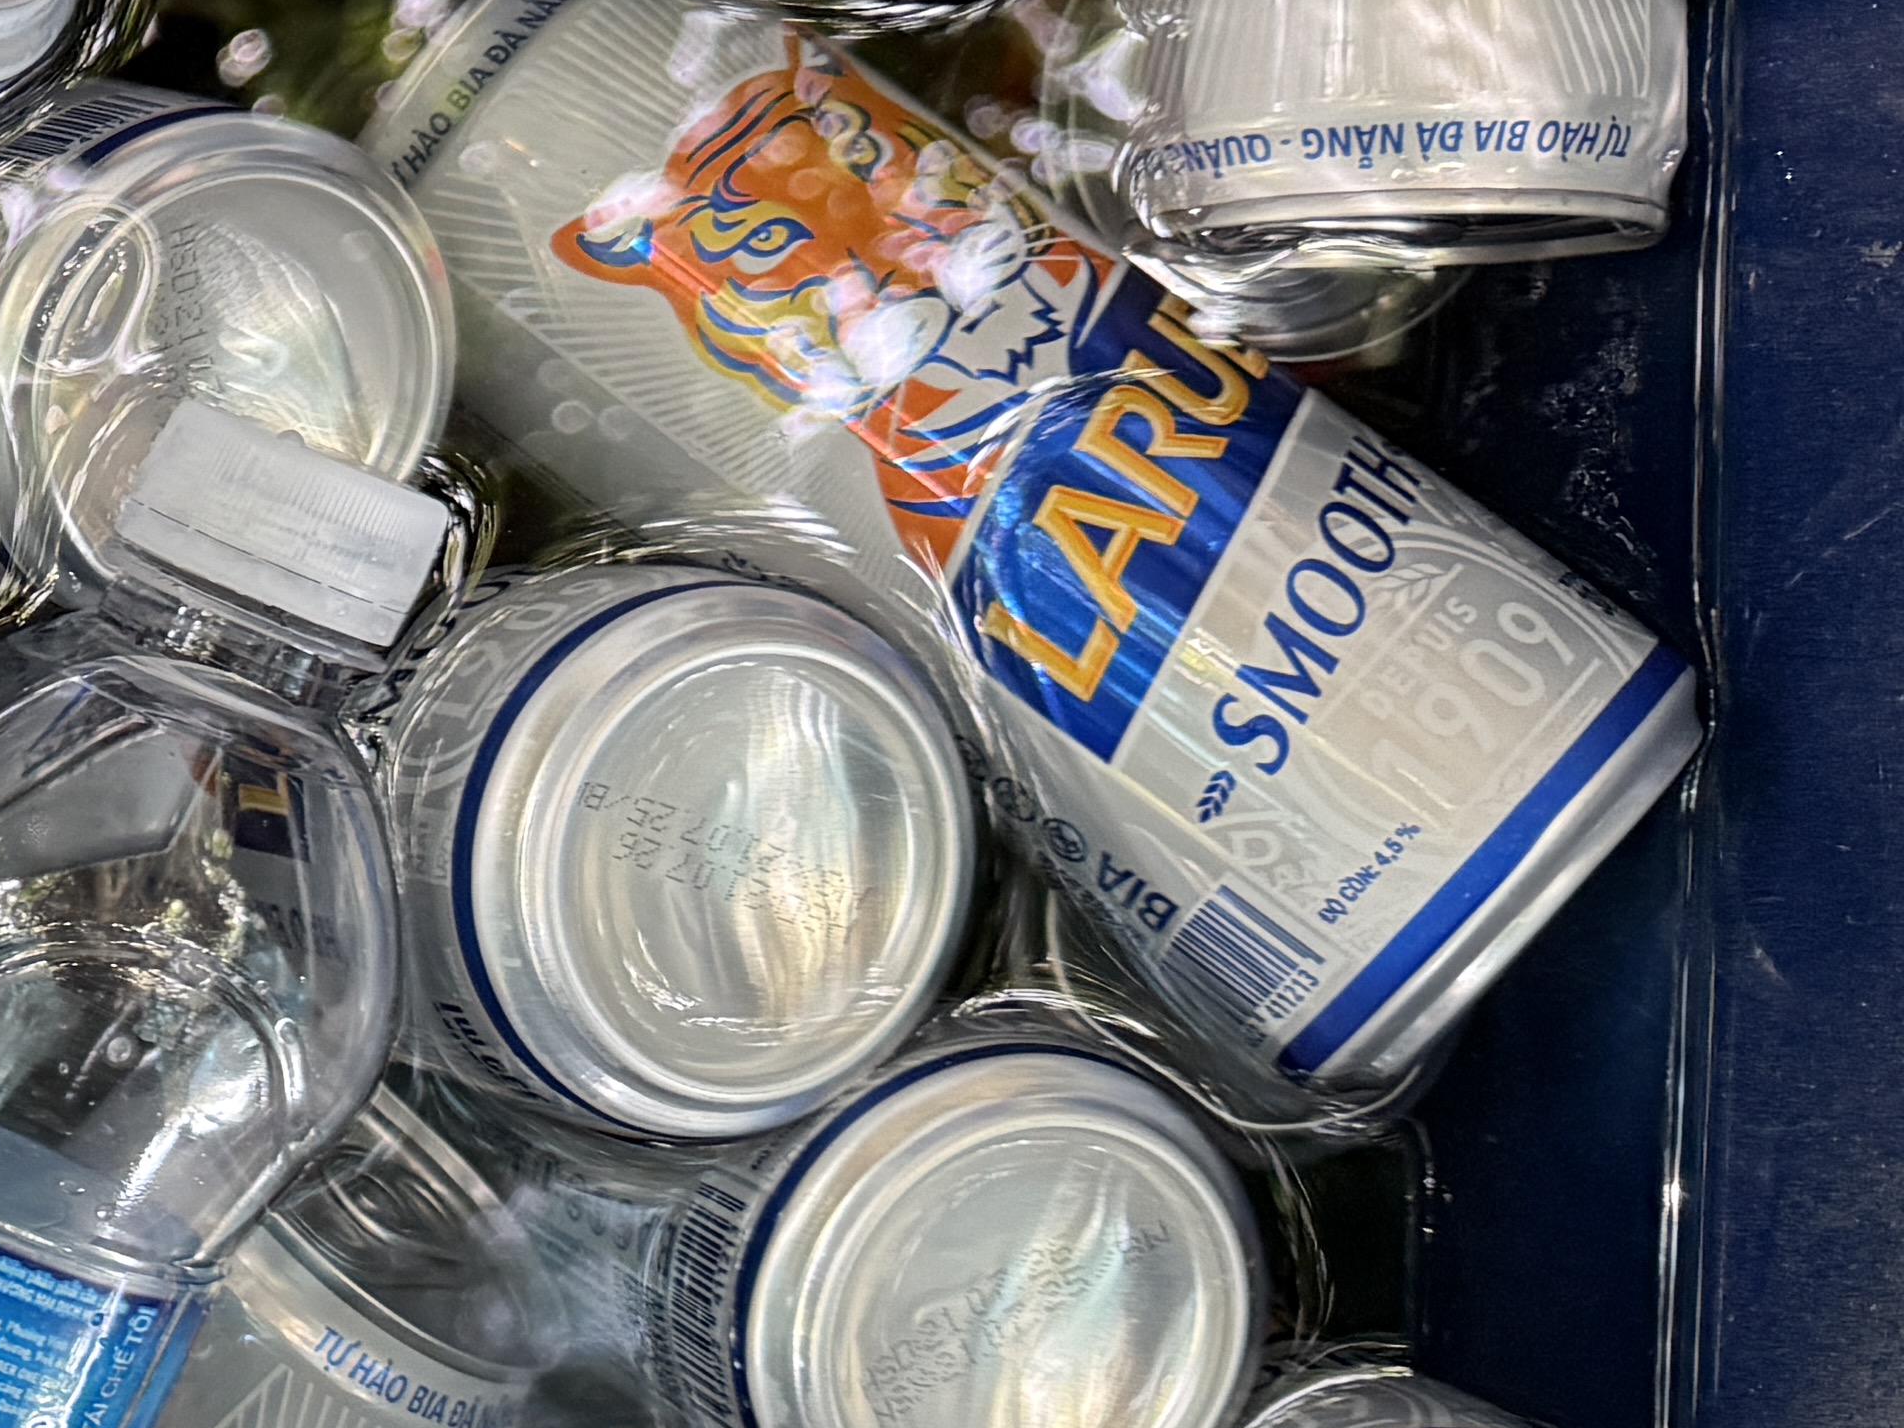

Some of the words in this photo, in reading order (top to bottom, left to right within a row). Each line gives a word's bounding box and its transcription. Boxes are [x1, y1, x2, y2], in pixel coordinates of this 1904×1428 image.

[401, 112, 453, 179] HÀO
[445, 67, 495, 113] BIA
[484, 30, 527, 66] ĐÀ
[1301, 122, 1404, 170] NẴNG
[1416, 121, 1464, 163] ĐÀ
[1476, 120, 1531, 154] BIA
[1538, 120, 1593, 163] HÀO
[1592, 115, 1633, 161] TỰ
[982, 294, 1264, 702] LARU
[1373, 831, 1405, 868] 4,5
[1094, 850, 1181, 934] BIA
[1266, 968, 1321, 1026] 411213
[98, 1344, 135, 1400] CHẾ
[119, 1300, 159, 1350] TÔI
[313, 1323, 355, 1374] TỰ
[348, 1351, 410, 1406] HÀO
[406, 1385, 448, 1425] BIA
